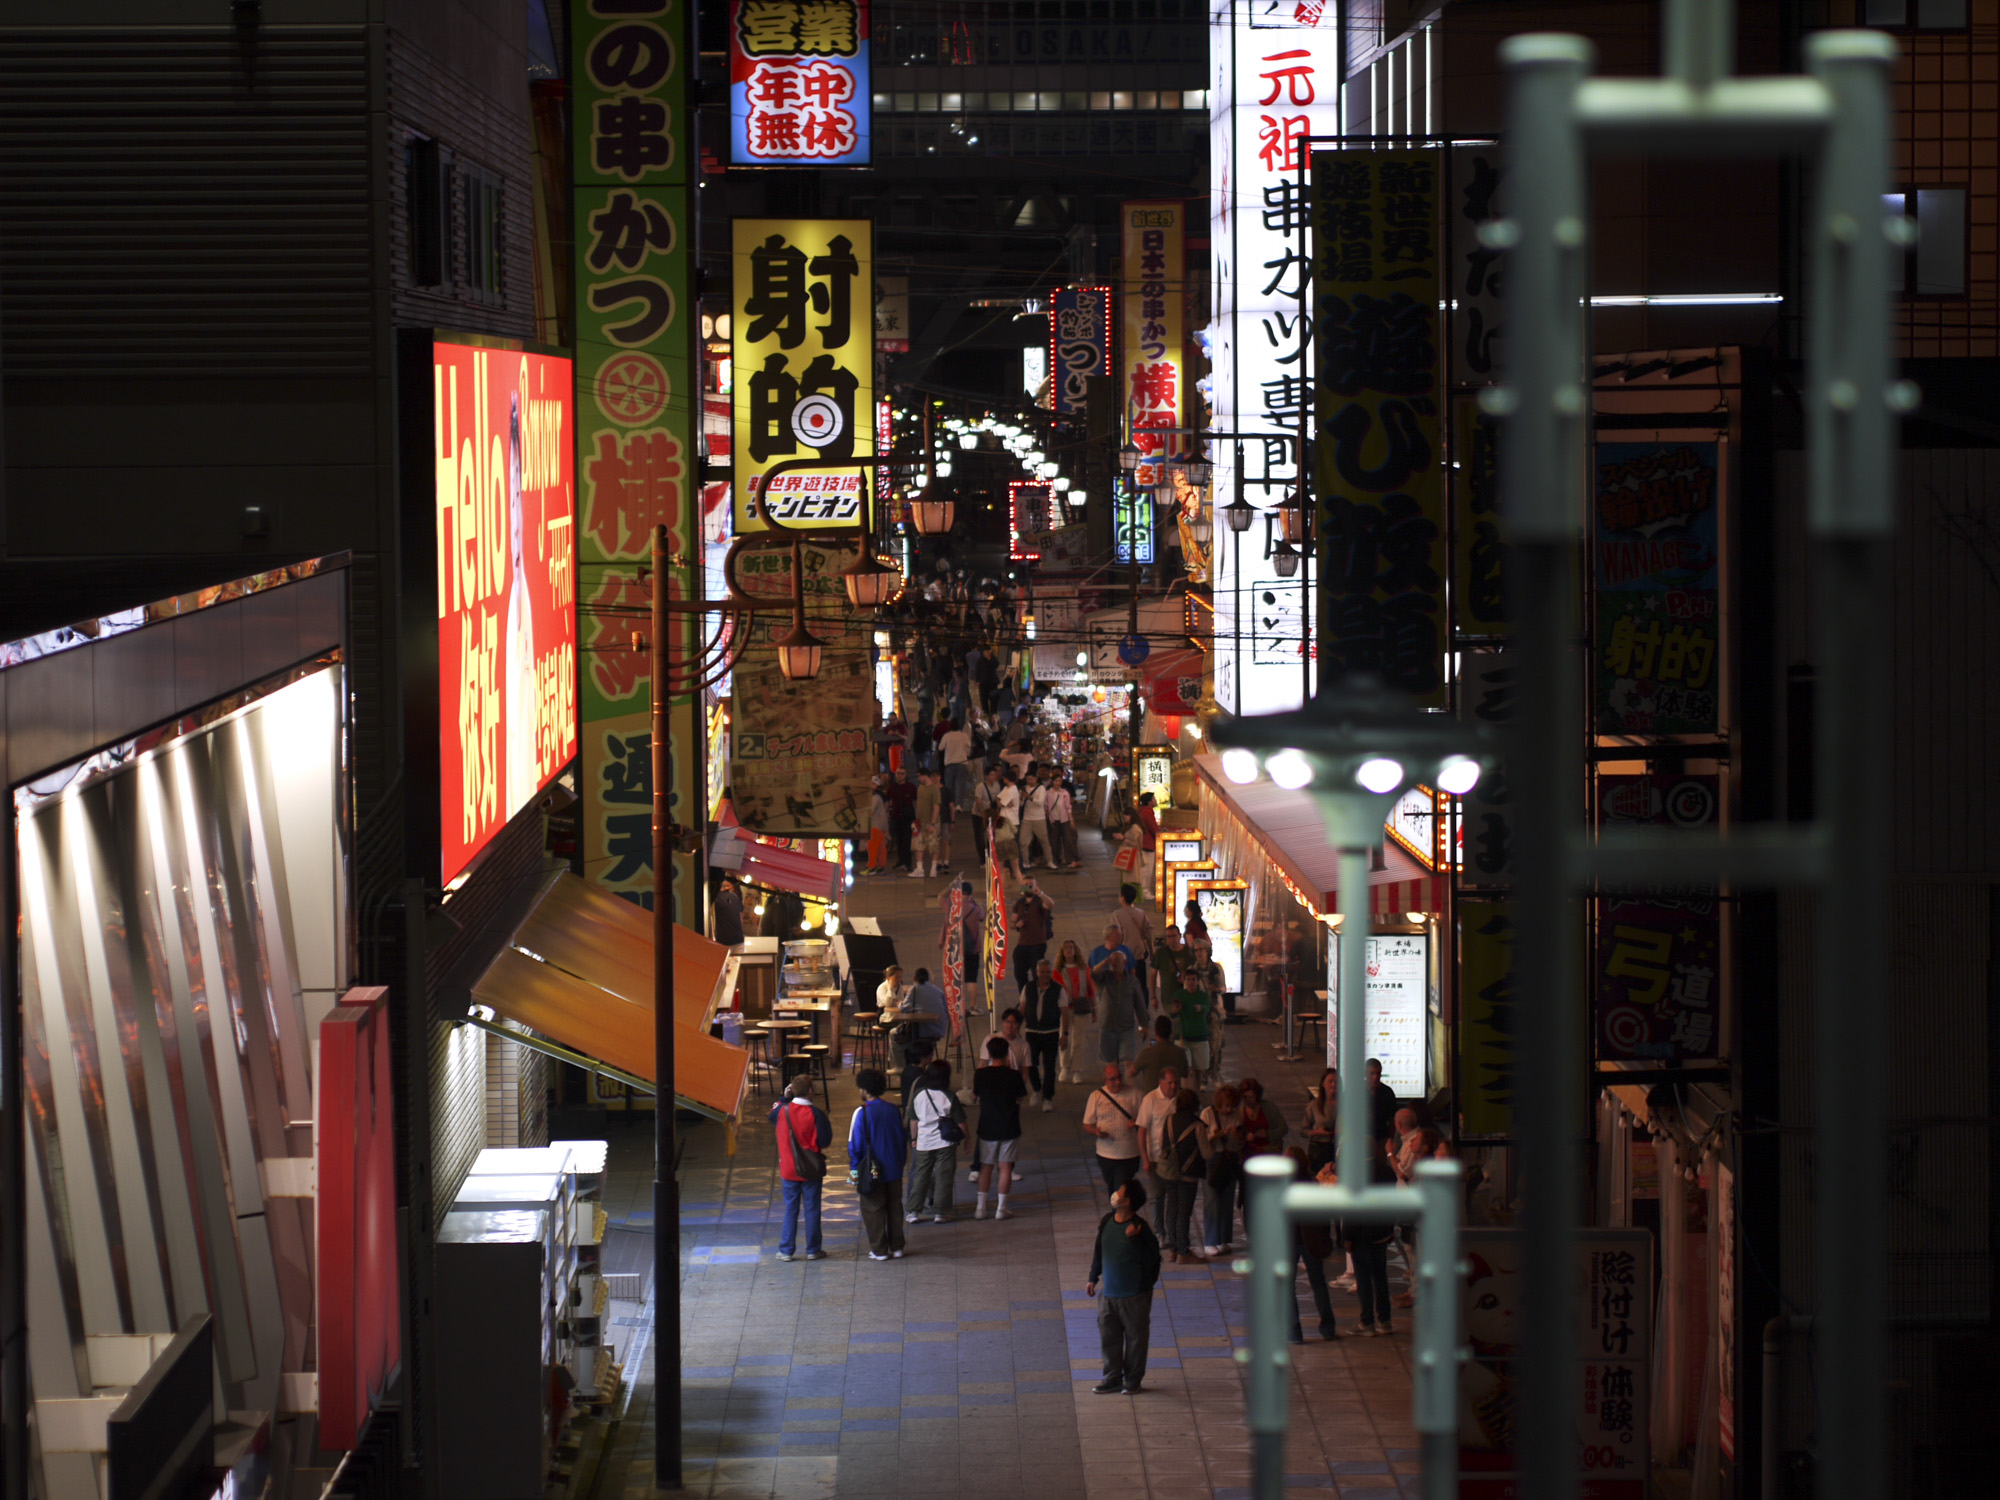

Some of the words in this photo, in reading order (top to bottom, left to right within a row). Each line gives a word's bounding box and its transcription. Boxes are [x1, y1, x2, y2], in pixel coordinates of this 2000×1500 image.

[742, 0, 855, 52] 営業
[1016, 29, 1153, 55] OSAKA!
[754, 68, 848, 110] 年中
[754, 111, 849, 150] 無休
[1131, 210, 1175, 228] 新世界
[1319, 160, 1373, 282] 遊技場
[1140, 229, 1167, 360] 日本一の串かつ
[743, 233, 860, 464] 射的
[1130, 361, 1177, 458] 横綱
[434, 350, 507, 620] Hello
[519, 354, 563, 563] Bonjour
[1601, 446, 1699, 486] スペシャル
[1604, 613, 1716, 691] 射的
[459, 604, 500, 845] 你好
[1656, 686, 1714, 721] 体験
[601, 733, 678, 913] 通天
[1601, 1250, 1635, 1354] 絵付け
